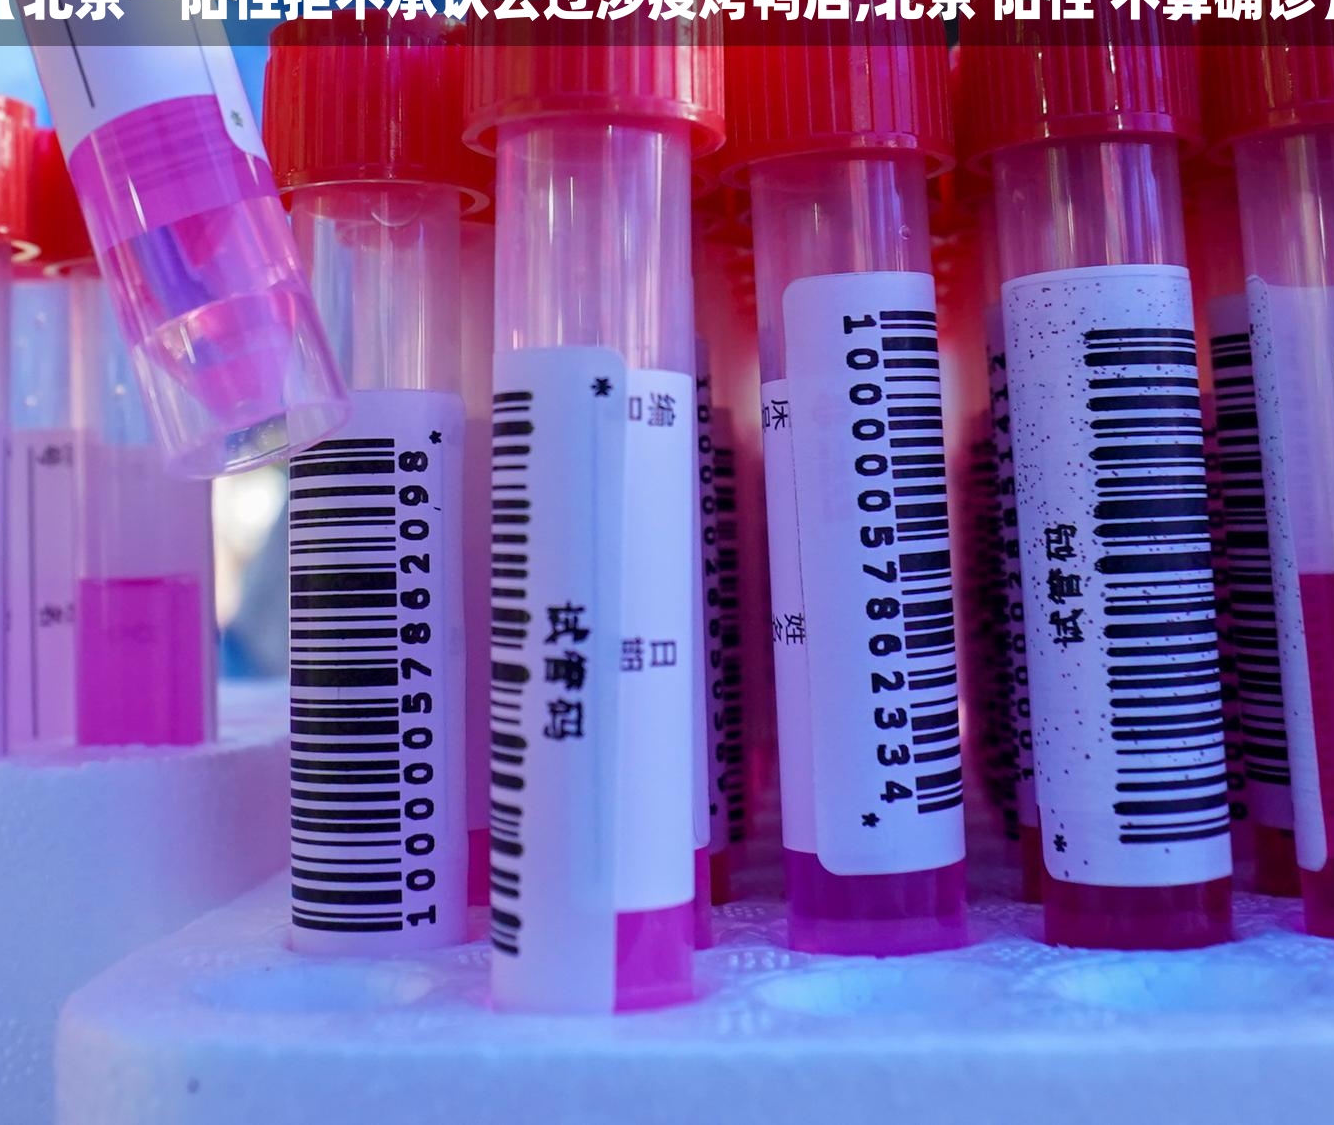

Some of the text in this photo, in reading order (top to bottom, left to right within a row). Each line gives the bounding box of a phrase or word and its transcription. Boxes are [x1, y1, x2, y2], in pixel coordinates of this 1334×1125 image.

[399, 449, 437, 927] 10000057862098
[543, 601, 591, 741] 试管码
[841, 312, 915, 804] 10000057862334
[1042, 523, 1087, 648] 试管码
